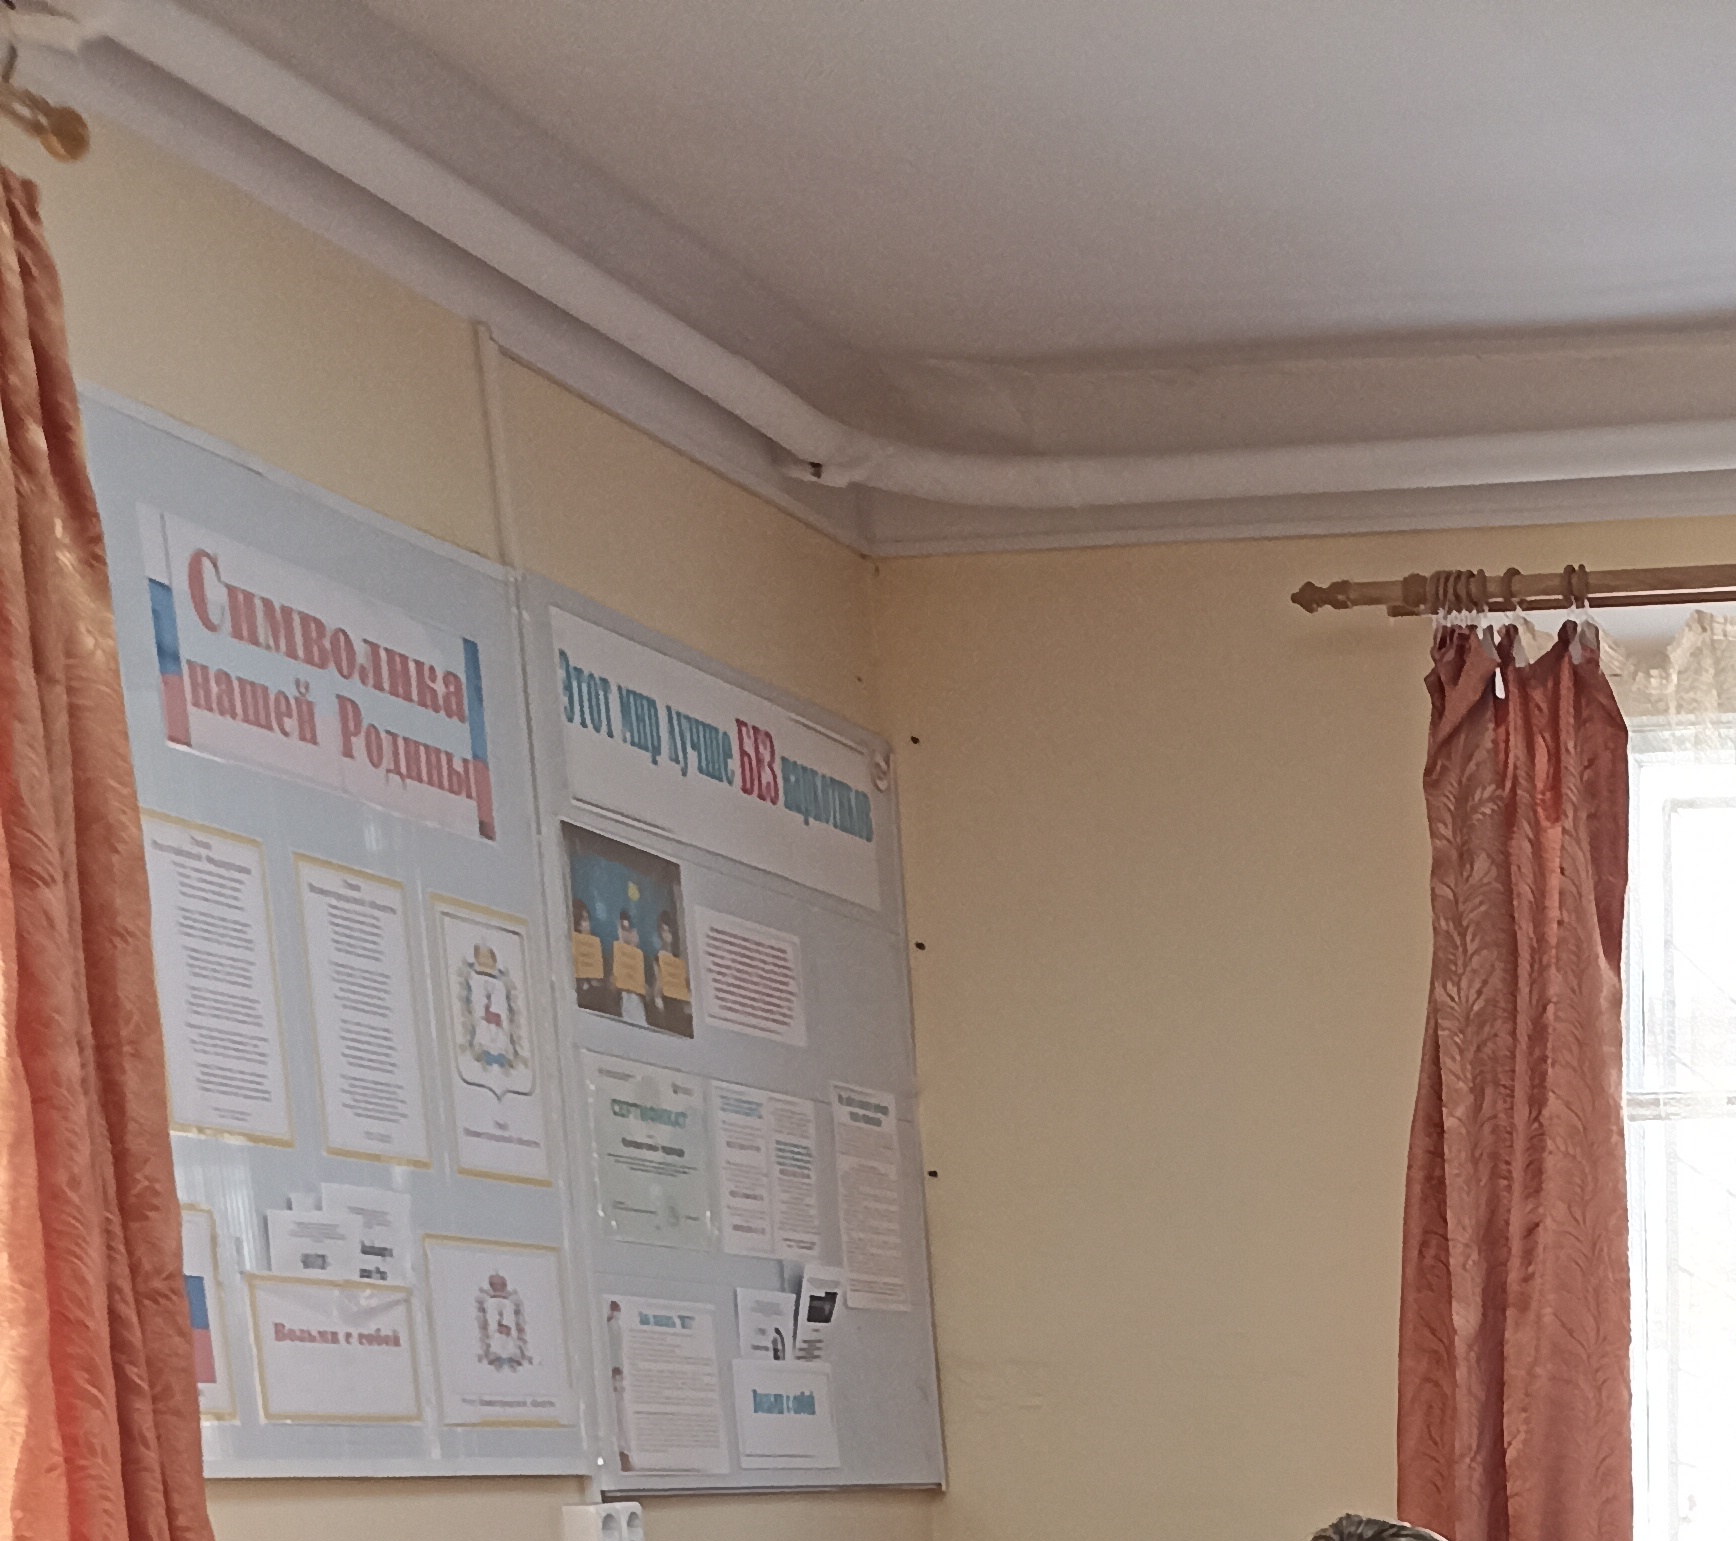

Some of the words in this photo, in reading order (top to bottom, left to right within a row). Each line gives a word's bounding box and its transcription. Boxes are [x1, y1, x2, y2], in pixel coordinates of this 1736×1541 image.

[187, 547, 467, 724] Символика
[185, 658, 318, 746] нашей
[336, 693, 478, 802] Родины
[558, 648, 614, 739] Этот
[617, 684, 662, 766] мир
[735, 718, 780, 806] БЕЗ
